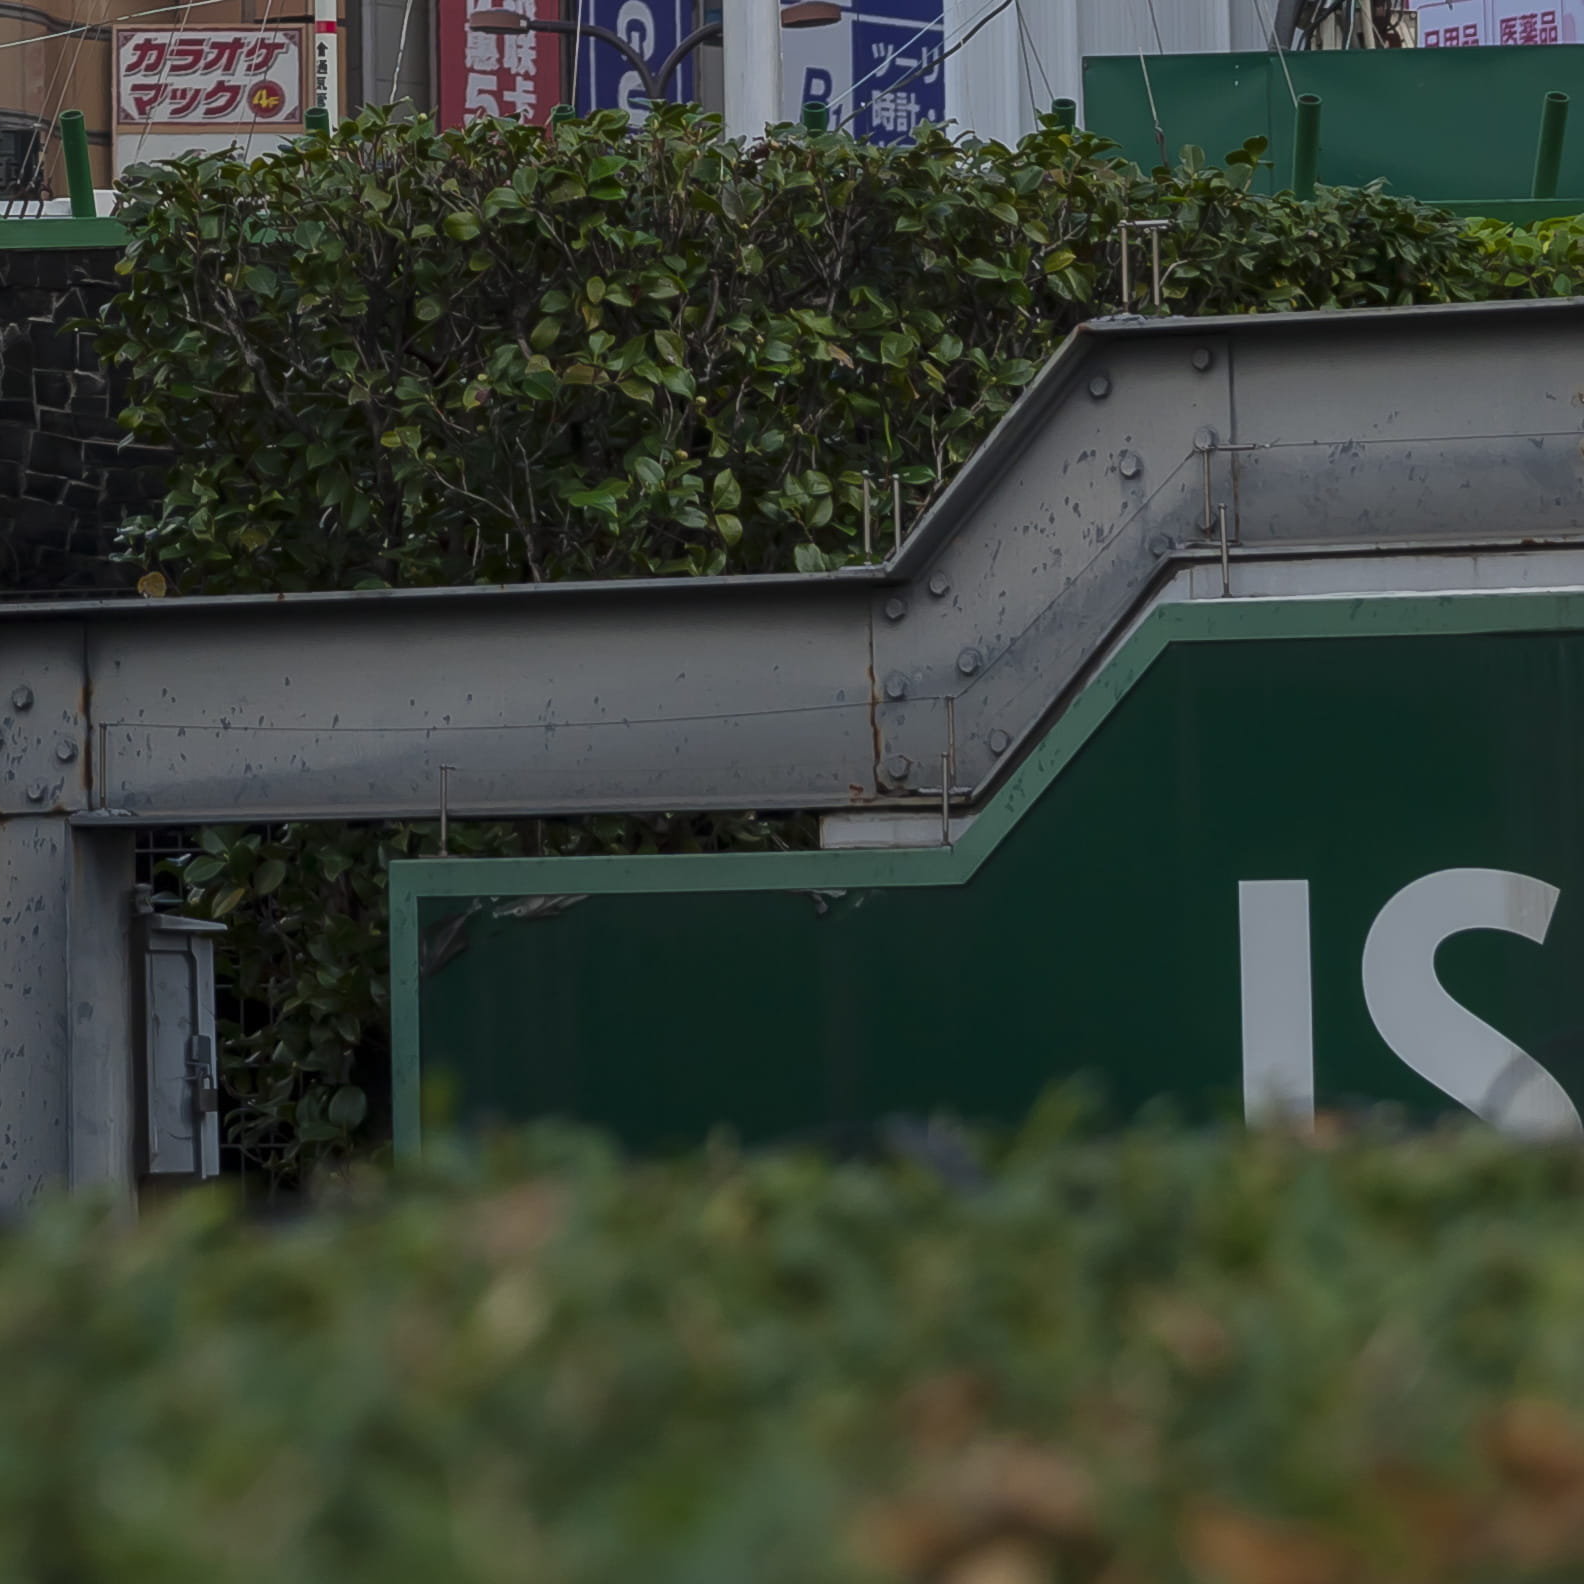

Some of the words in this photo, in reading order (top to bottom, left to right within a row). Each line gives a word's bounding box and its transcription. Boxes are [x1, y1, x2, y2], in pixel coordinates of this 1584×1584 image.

[124, 36, 288, 76] カラオケ
[129, 79, 247, 119] マック
[251, 88, 281, 109] 4F
